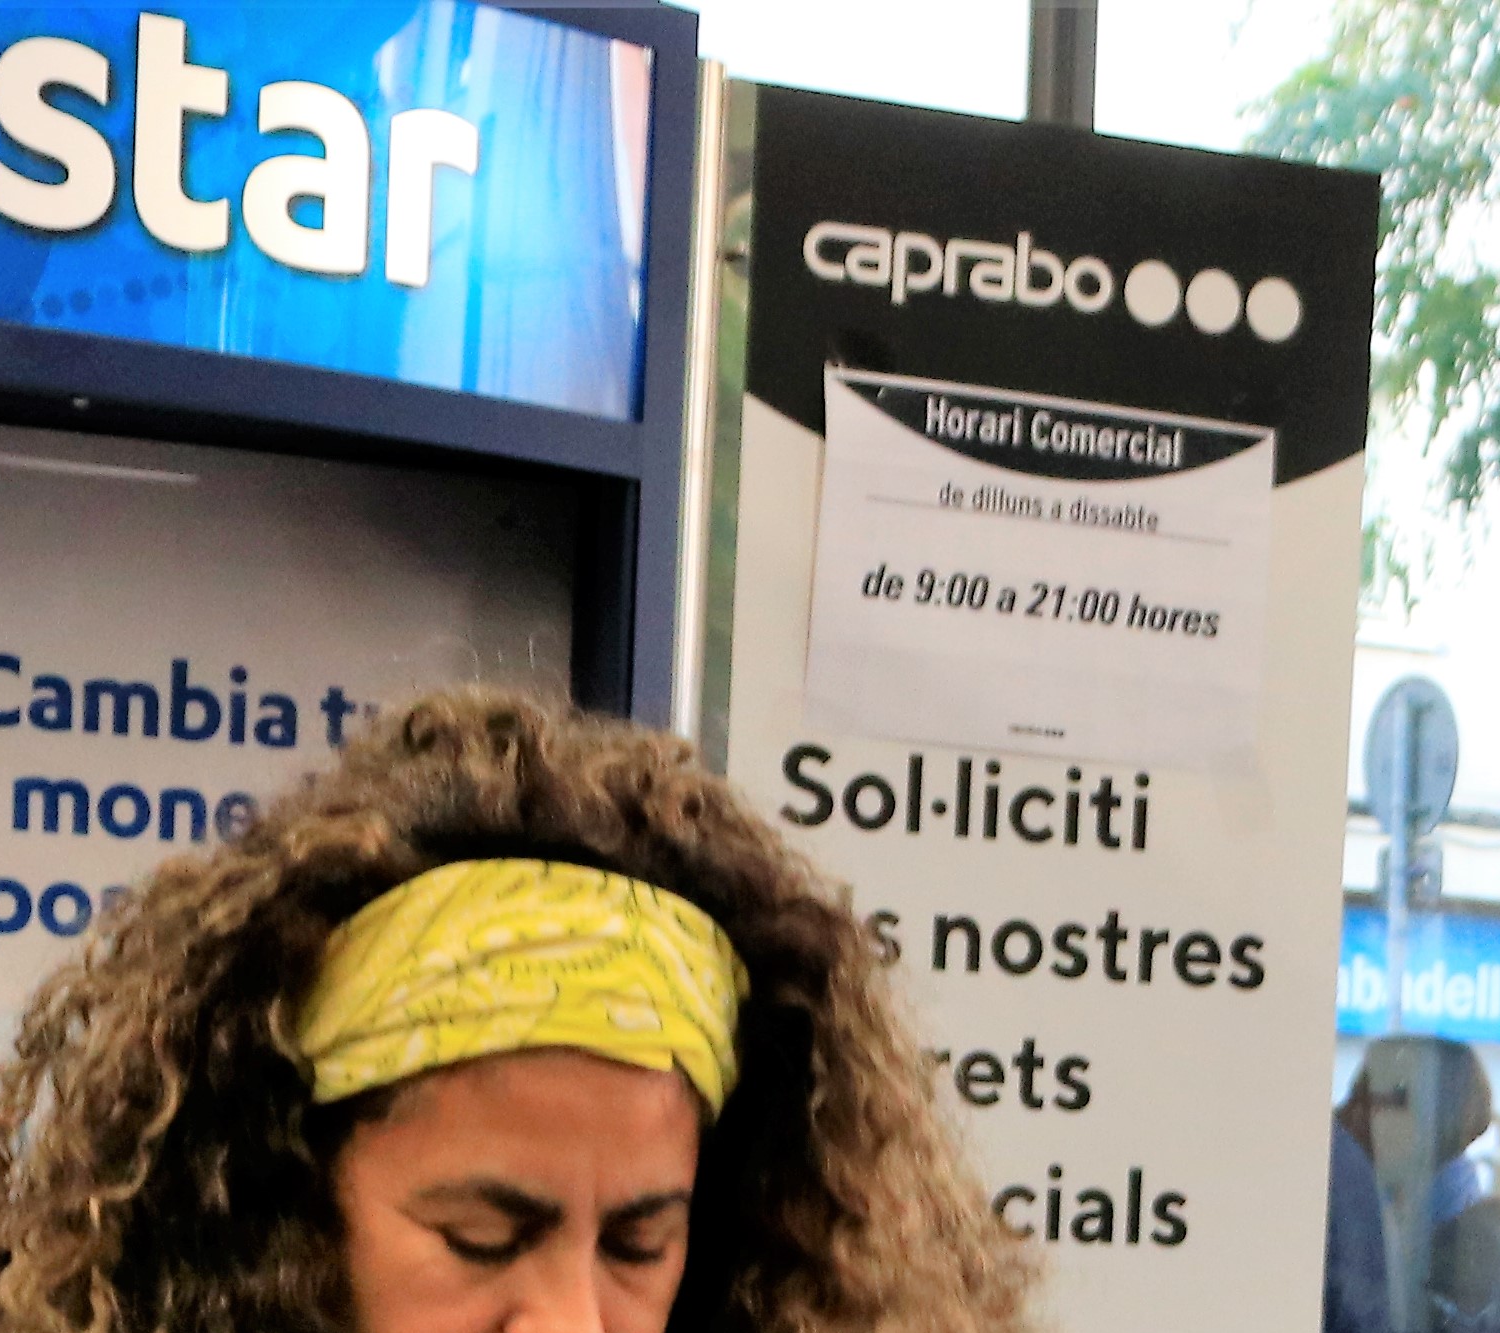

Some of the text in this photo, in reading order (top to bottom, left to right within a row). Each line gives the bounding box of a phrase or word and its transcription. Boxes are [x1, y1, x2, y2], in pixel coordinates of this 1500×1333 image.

[803, 221, 1115, 314] caprabo
[925, 396, 1184, 468] Horari Comercial
[938, 481, 964, 507] de
[972, 484, 1043, 519] dilluns
[860, 563, 1220, 639] de 9:00 a 21:00 hores
[12, 775, 266, 845] mone
[931, 910, 1267, 992] nostres
